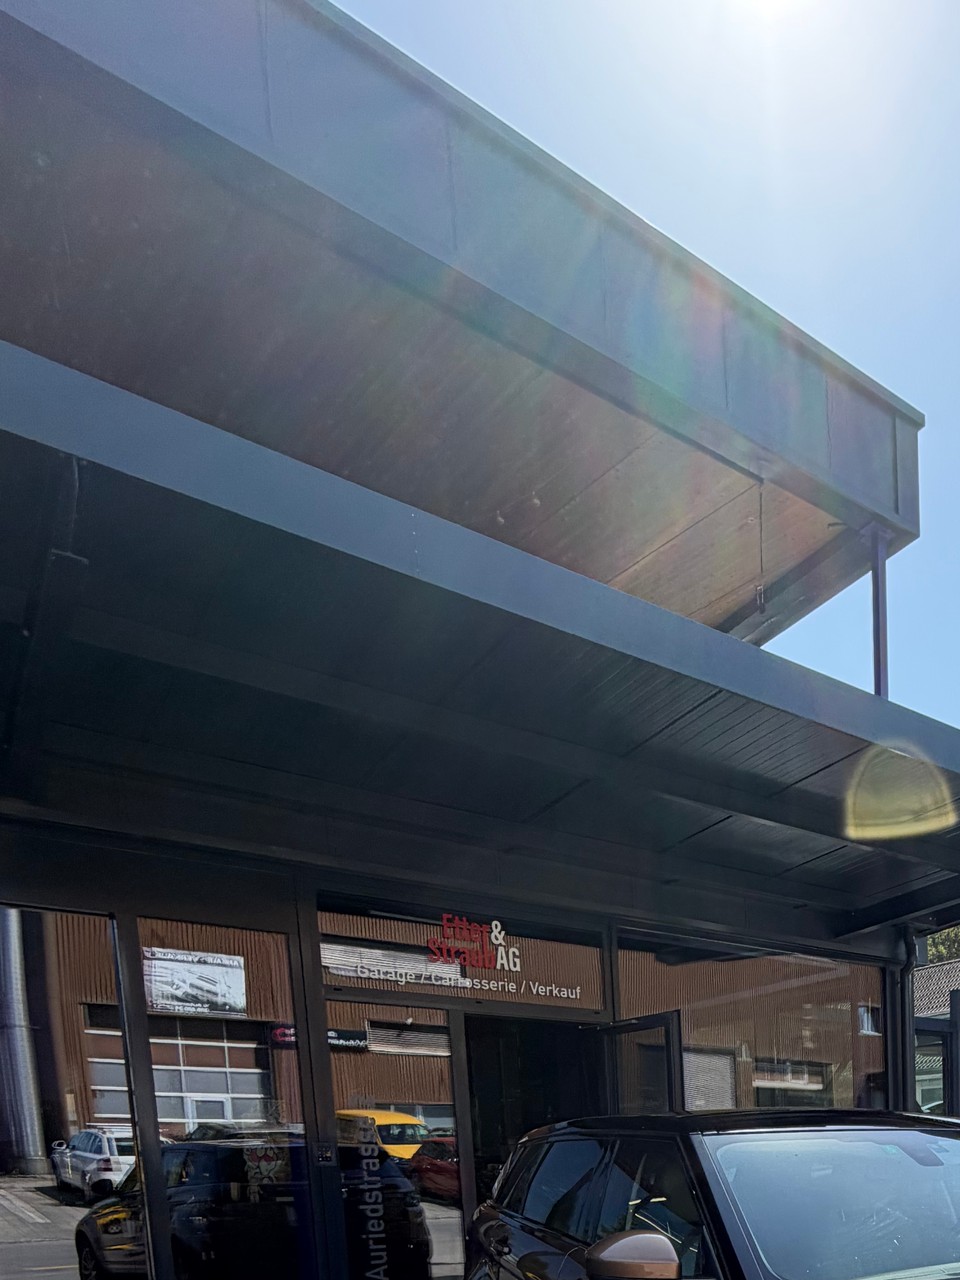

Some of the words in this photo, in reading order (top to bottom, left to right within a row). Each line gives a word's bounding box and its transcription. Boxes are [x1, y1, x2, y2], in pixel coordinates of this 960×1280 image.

[442, 913, 491, 943] Etter
[491, 920, 506, 946] &
[427, 937, 496, 970] Straub
[496, 946, 521, 972] AG
[357, 964, 415, 985] Garage
[432, 973, 516, 992] Carrosserie
[529, 981, 581, 999] Verkauf
